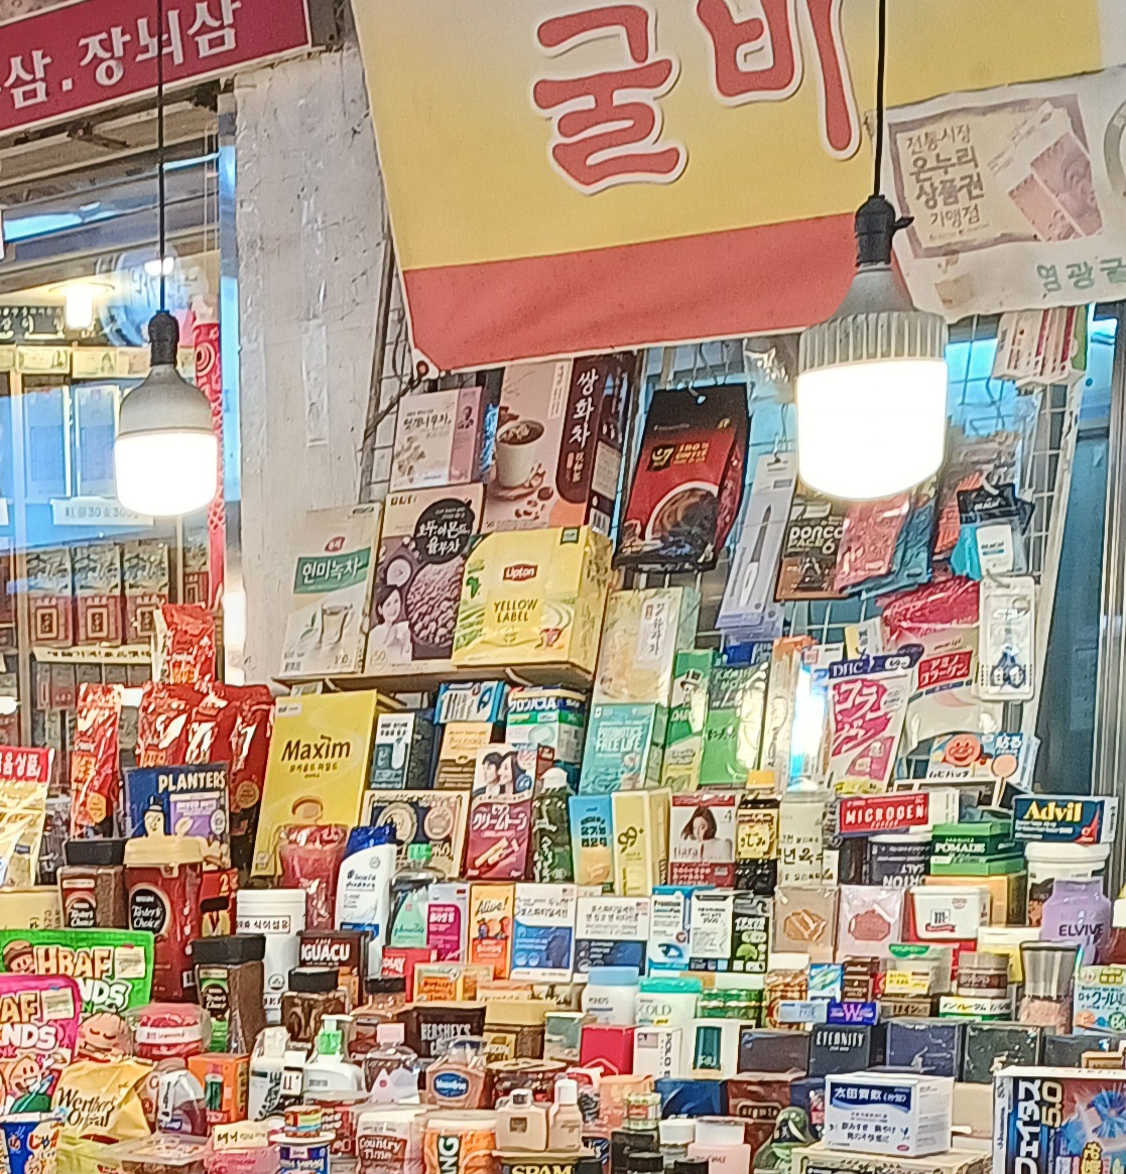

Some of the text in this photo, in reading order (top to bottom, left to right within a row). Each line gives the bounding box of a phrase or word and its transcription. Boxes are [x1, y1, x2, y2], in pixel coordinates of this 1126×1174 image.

[532, 0, 862, 194] 굴비
[906, 123, 973, 156] 전통시장
[909, 145, 979, 184] 온누리
[916, 172, 984, 210] 상품권
[929, 203, 981, 229] 가맹점
[568, 367, 599, 449] 쌍화차
[503, 566, 538, 581] Lipton
[494, 599, 539, 614] YELLOW
[497, 611, 531, 624] LABEL
[832, 661, 864, 677] DHC
[281, 738, 351, 763] Maxim
[157, 770, 225, 793] PLANTERS
[1023, 800, 1083, 822] Advil
[476, 896, 509, 916] Alive!
[1059, 923, 1105, 937] ELVIVE
[34, 948, 113, 980] HBAF
[1042, 1080, 1063, 1128] 5.0
[358, 1137, 402, 1152] Country
[363, 1149, 393, 1160] Time
